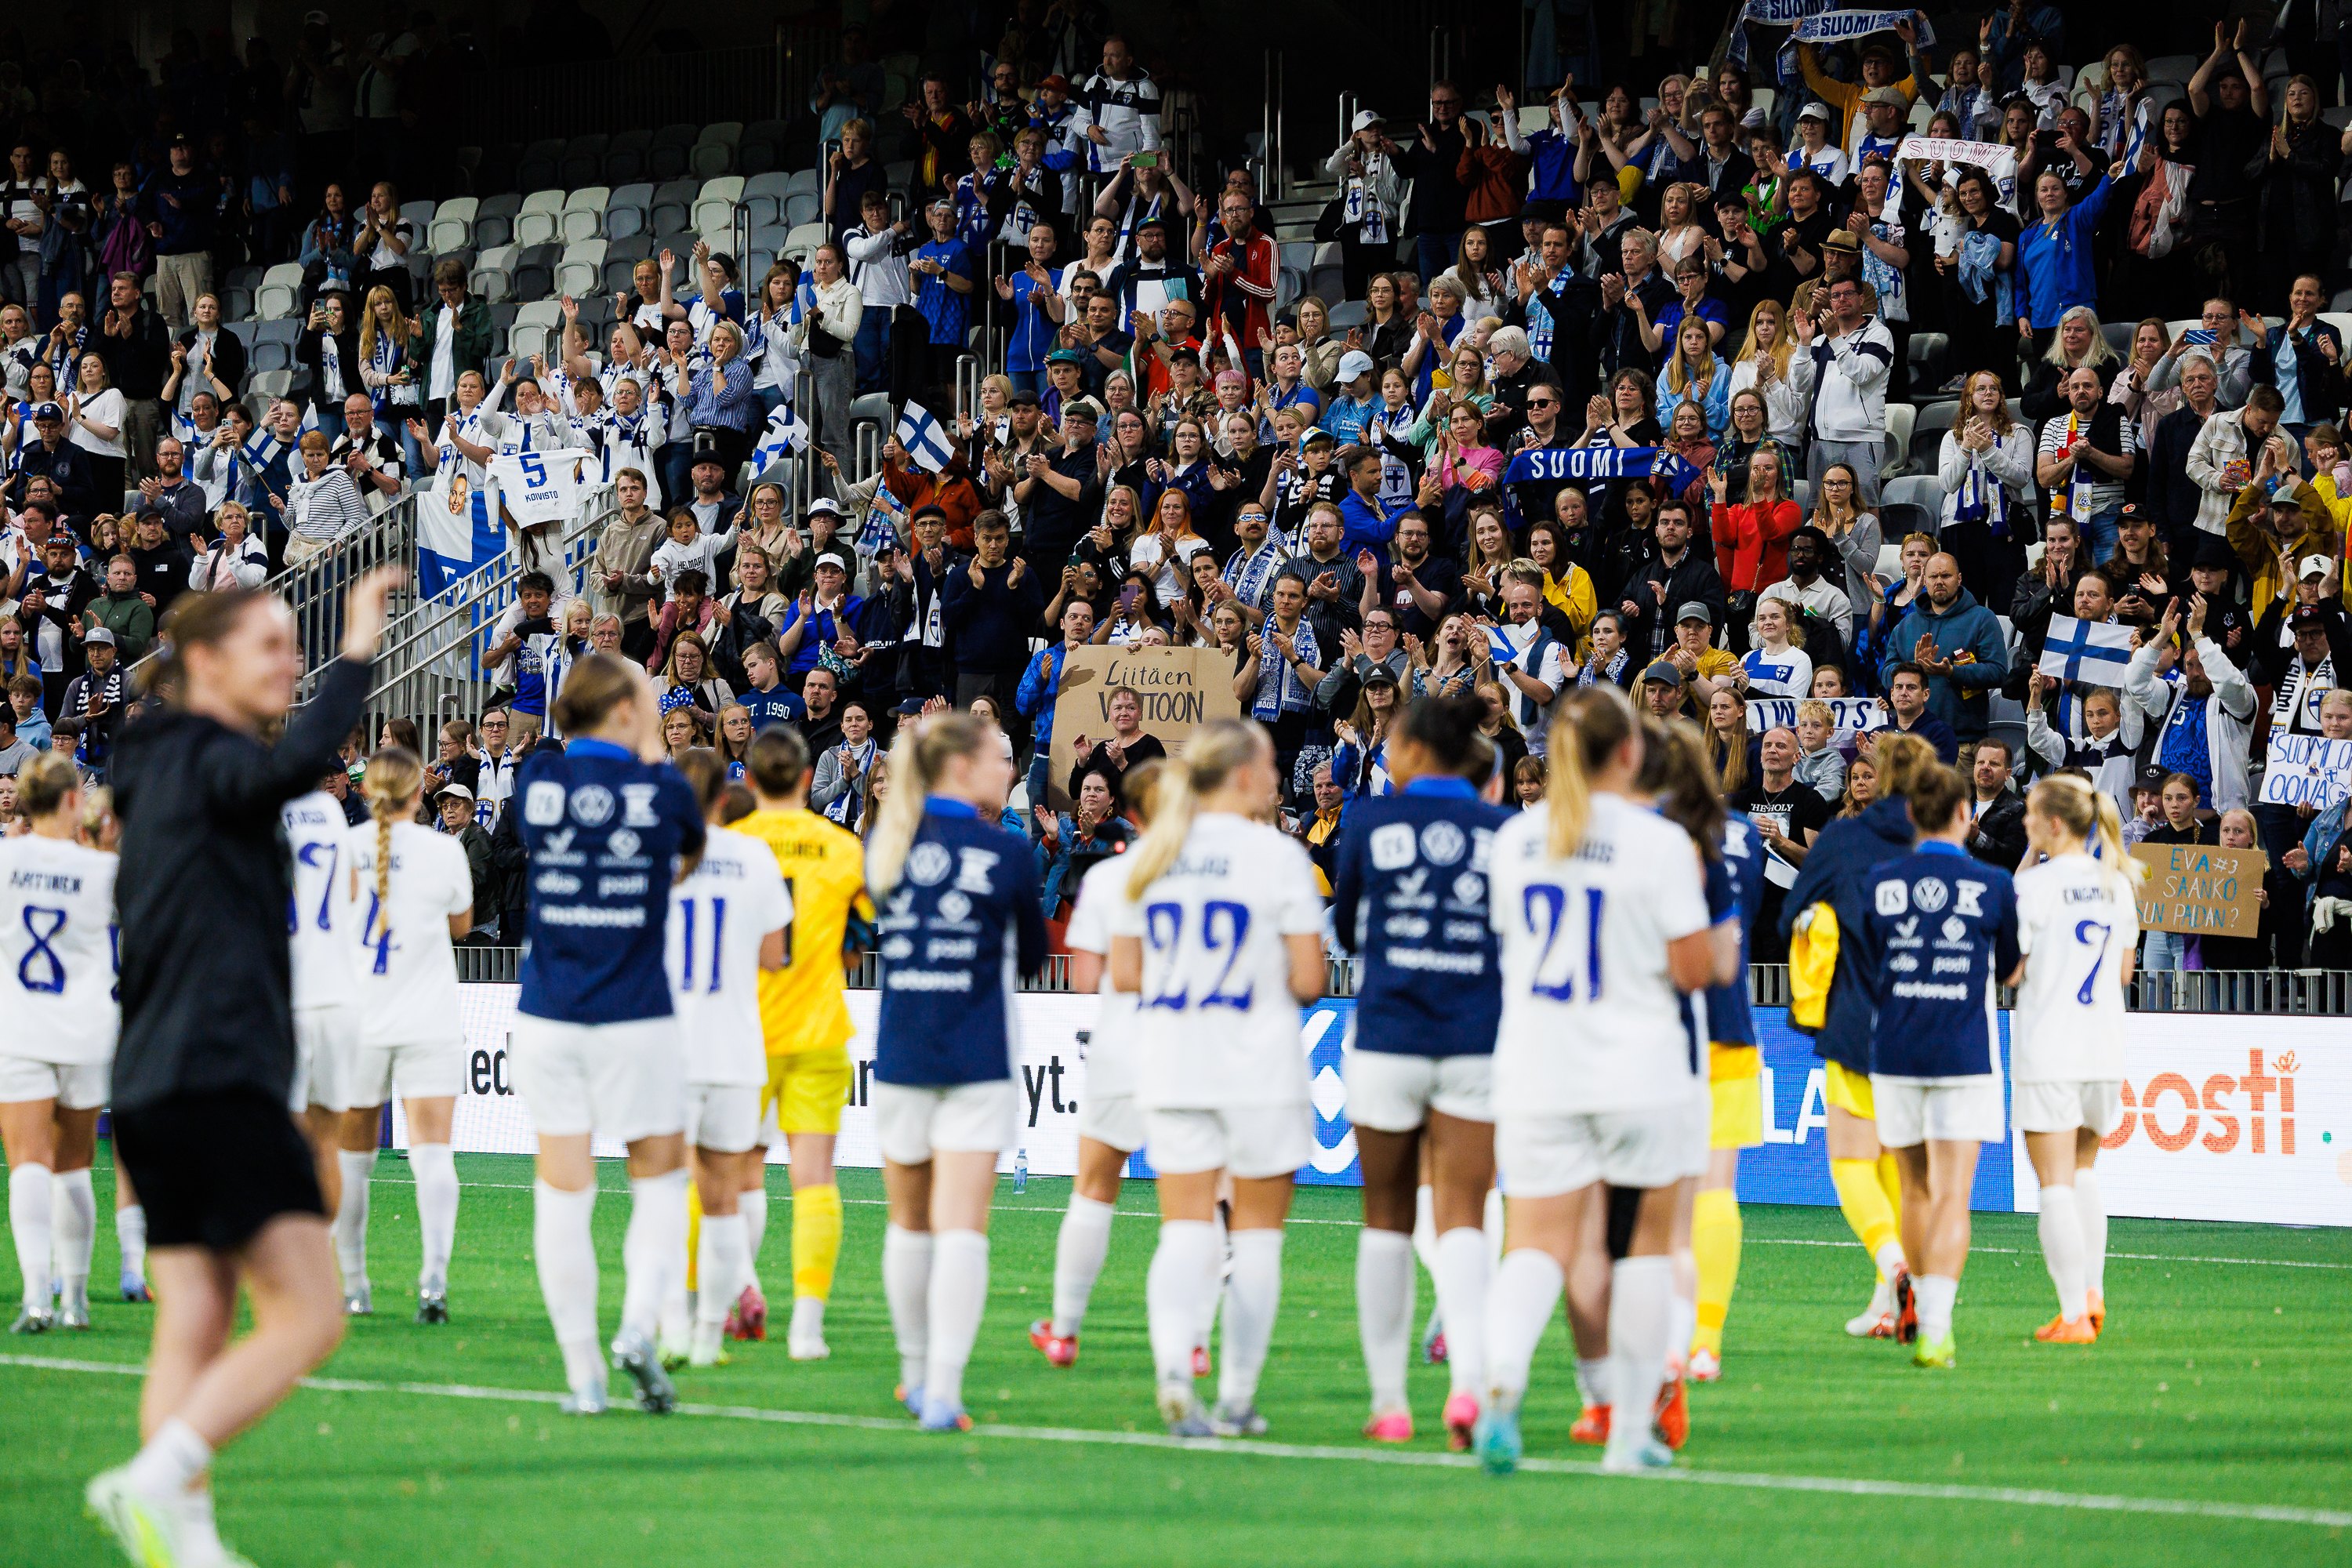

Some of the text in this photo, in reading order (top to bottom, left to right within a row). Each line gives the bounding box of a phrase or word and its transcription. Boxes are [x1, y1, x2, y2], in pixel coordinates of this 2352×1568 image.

[1820, 14, 1877, 37] SUOMI
[1907, 140, 2011, 169] SUOMI
[518, 452, 547, 488] 5
[1530, 448, 1625, 479] SUOMI
[524, 490, 559, 503] KOIVISTO
[1104, 659, 1192, 687] Liitäen
[765, 701, 790, 720] 1990
[2172, 705, 2190, 726] 5
[2272, 733, 2333, 768] SUOMI
[2268, 773, 2328, 808] OONA
[1768, 803, 1795, 814] HOLY
[2170, 848, 2239, 875] EVA #3
[2162, 875, 2238, 902] SAANKO
[2136, 901, 2165, 925] SUN
[362, 887, 401, 975] 4
[679, 896, 727, 996] 11
[1522, 880, 1606, 1004] 21
[18, 905, 67, 996] 8
[1137, 899, 1254, 1011] 22
[2074, 919, 2111, 1006] 7
